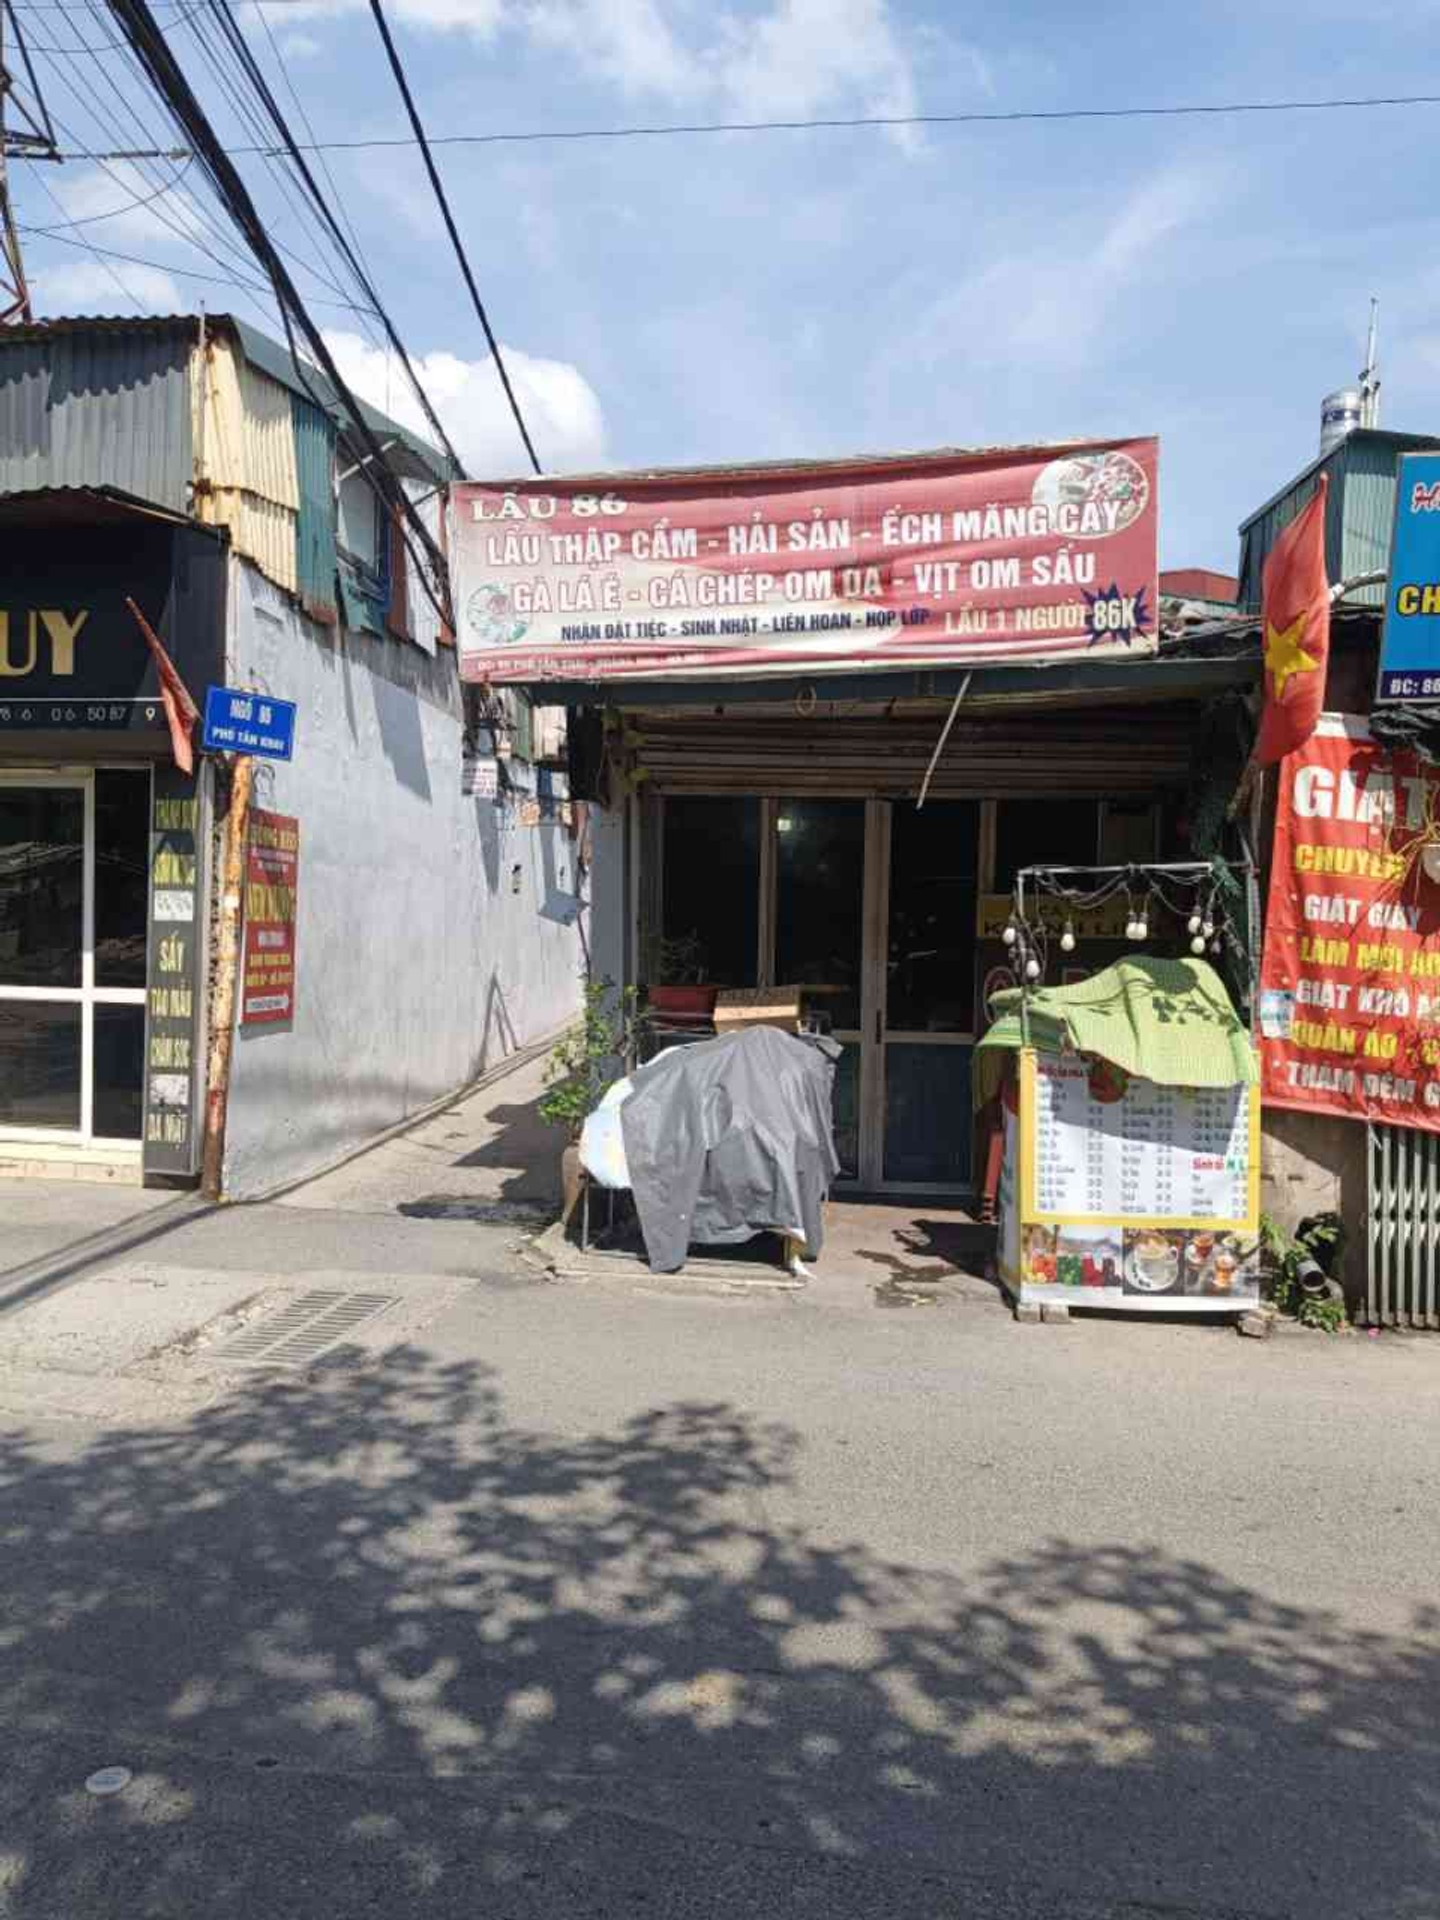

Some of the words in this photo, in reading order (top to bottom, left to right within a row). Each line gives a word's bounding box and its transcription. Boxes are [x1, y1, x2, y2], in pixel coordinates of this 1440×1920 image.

[571, 491, 628, 518] 86
[486, 522, 540, 565] LẨU
[548, 527, 620, 570] THẬP
[631, 517, 698, 560] CẨM
[706, 539, 720, 548] -
[728, 510, 778, 554] HẢI
[787, 506, 850, 551] SẢN
[858, 531, 872, 540] -
[882, 504, 941, 545] ẾCH
[952, 502, 1050, 540] MĂNG
[1059, 501, 1121, 533] CAY
[513, 576, 553, 613] GÀ
[648, 570, 691, 609] CÁ
[696, 565, 774, 604] CHÉP
[784, 568, 832, 602] OM
[914, 562, 961, 599] VỊT
[971, 558, 1021, 589] OM
[1031, 543, 1096, 585] SẤU
[561, 624, 601, 645] NHẬN
[603, 622, 632, 643] ĐẶT
[636, 620, 667, 640] TIỆC
[681, 617, 716, 637] SINH
[719, 614, 759, 638] NHẬT
[773, 612, 805, 633] LIÊN
[810, 612, 852, 631] HOAN
[866, 610, 897, 629] HỌP
[901, 604, 931, 625] LỚP
[944, 600, 988, 635] LẨU
[1015, 598, 1087, 631] NGƯỜI
[1092, 597, 1138, 630] 86K
[0, 610, 88, 675] UY
[1305, 894, 1362, 928] GIẶT
